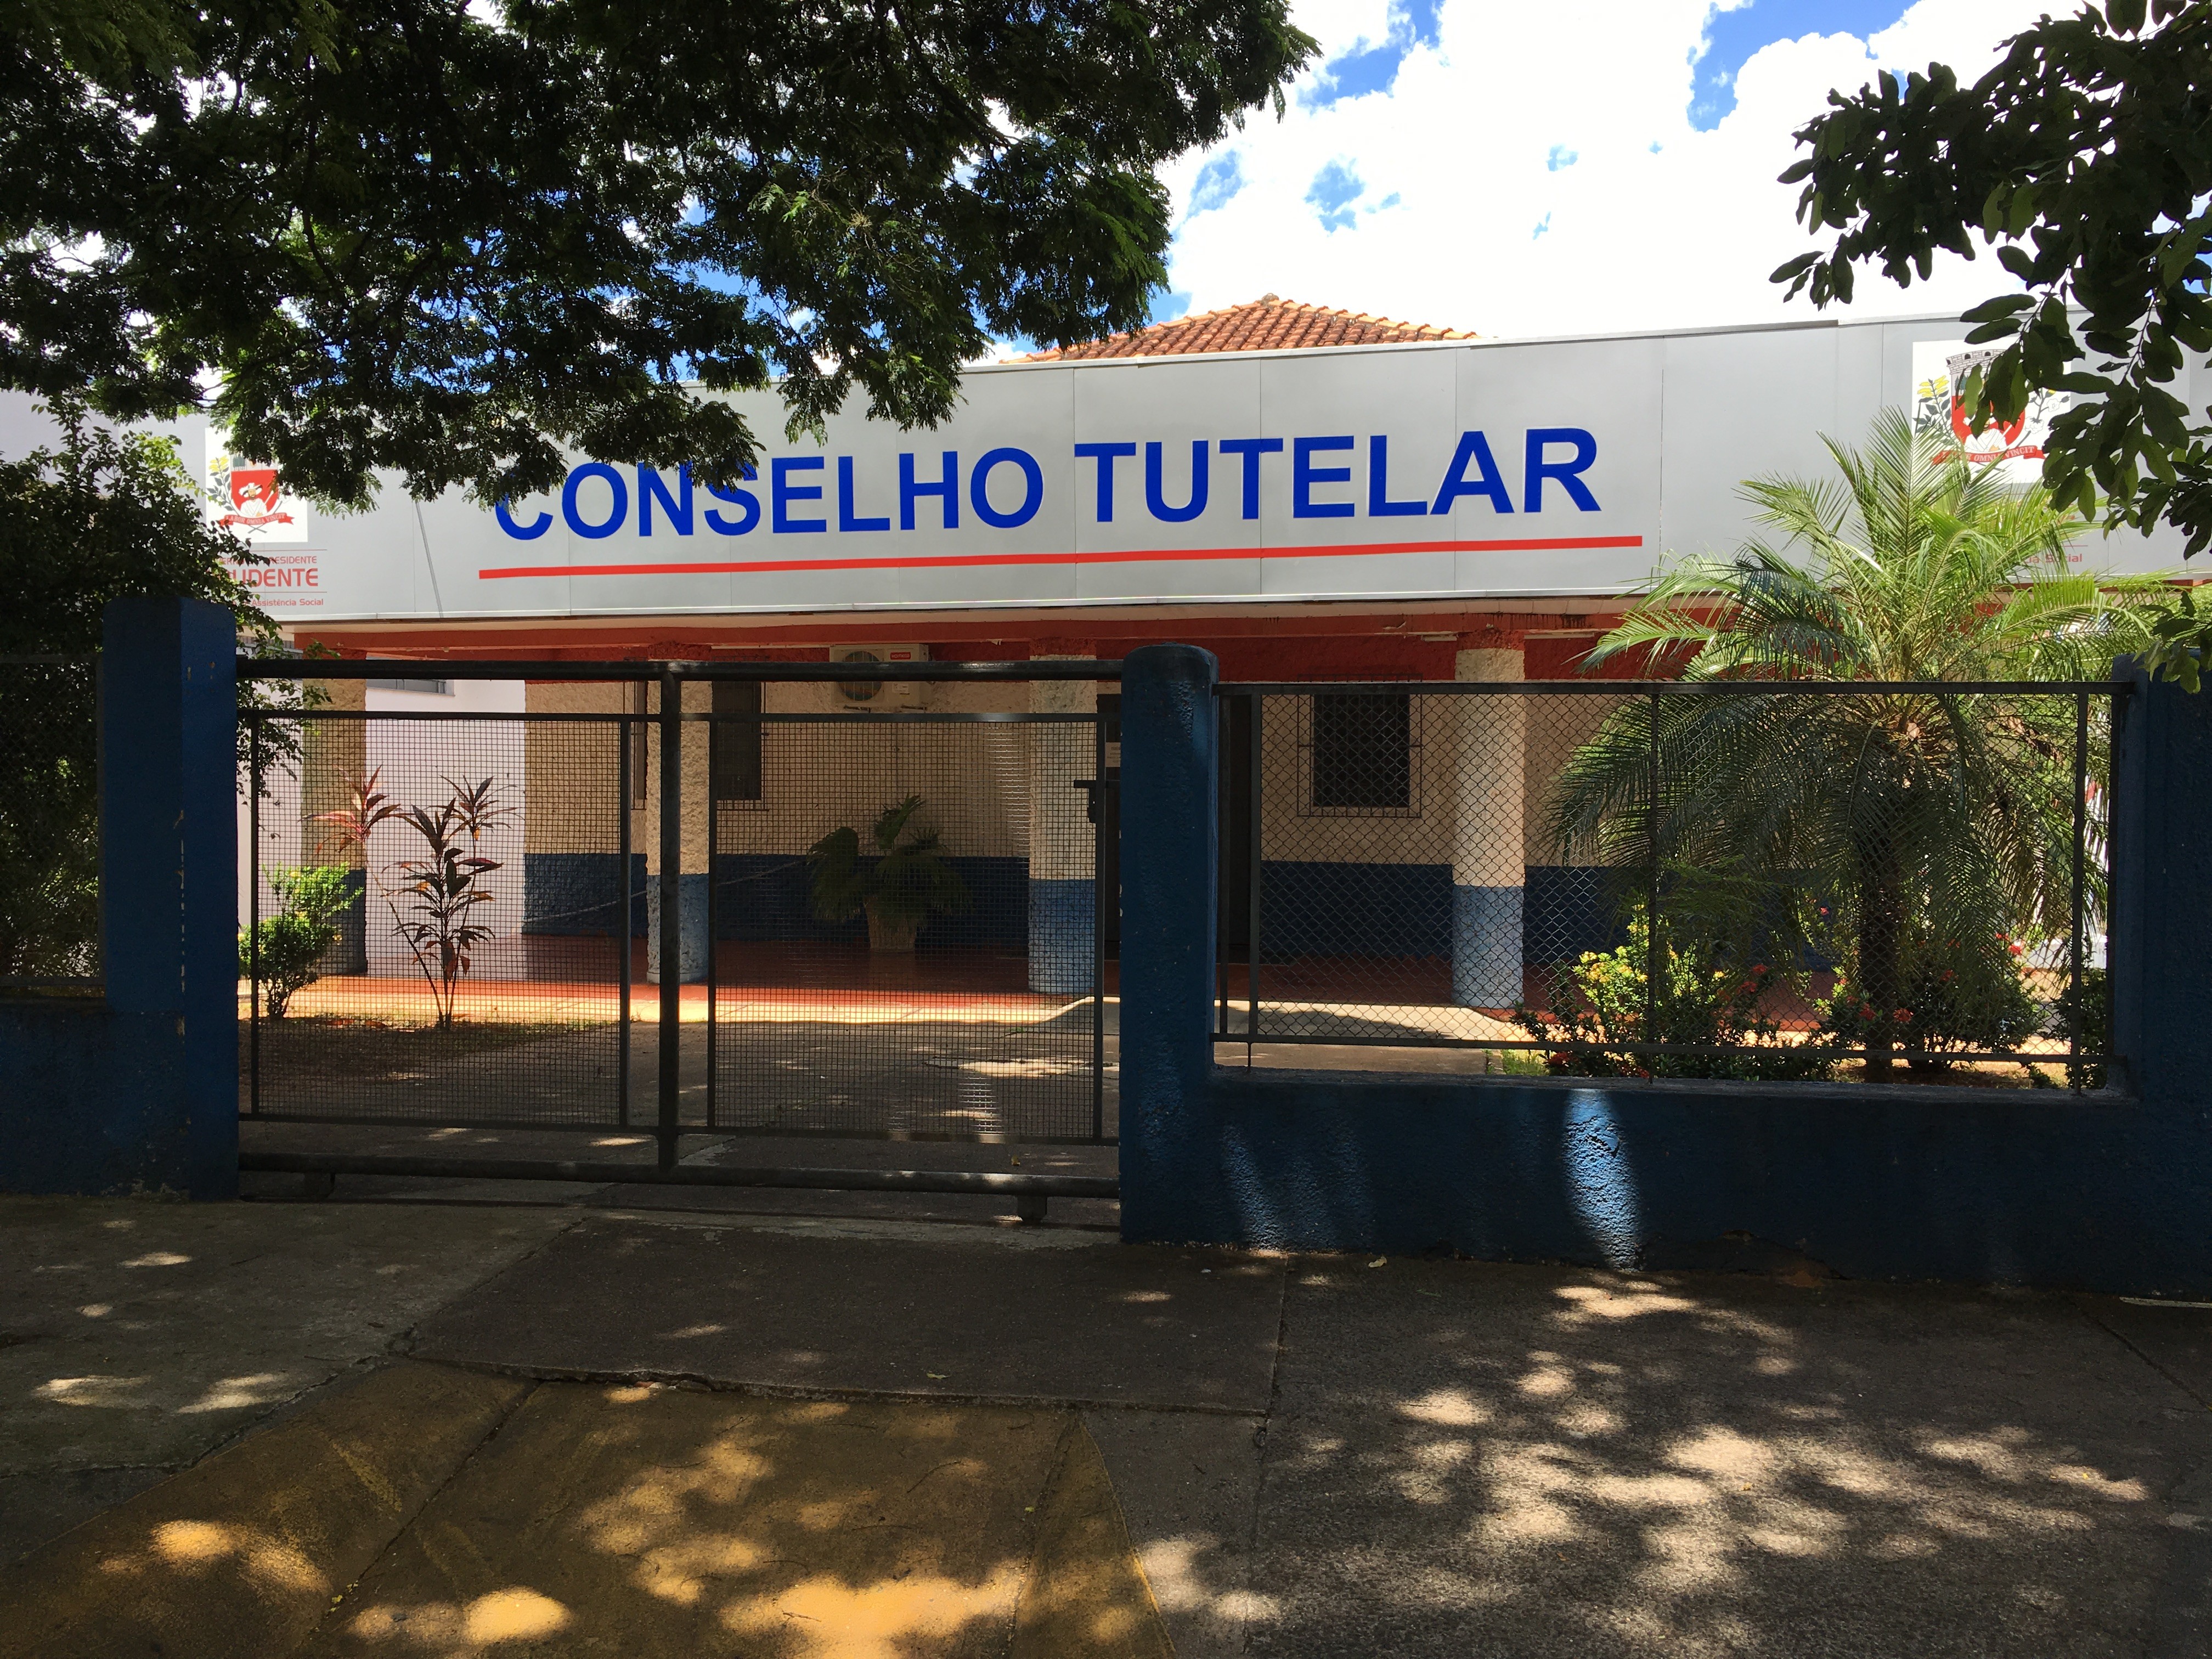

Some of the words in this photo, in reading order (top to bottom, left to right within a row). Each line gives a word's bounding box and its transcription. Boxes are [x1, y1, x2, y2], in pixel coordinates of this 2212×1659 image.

[1974, 453, 2000, 461] OMNI
[2005, 445, 2035, 458] VINCIT
[1074, 427, 1601, 523] TUTELAR
[265, 513, 286, 522] VINCIT
[267, 556, 317, 564] RESIDENTE
